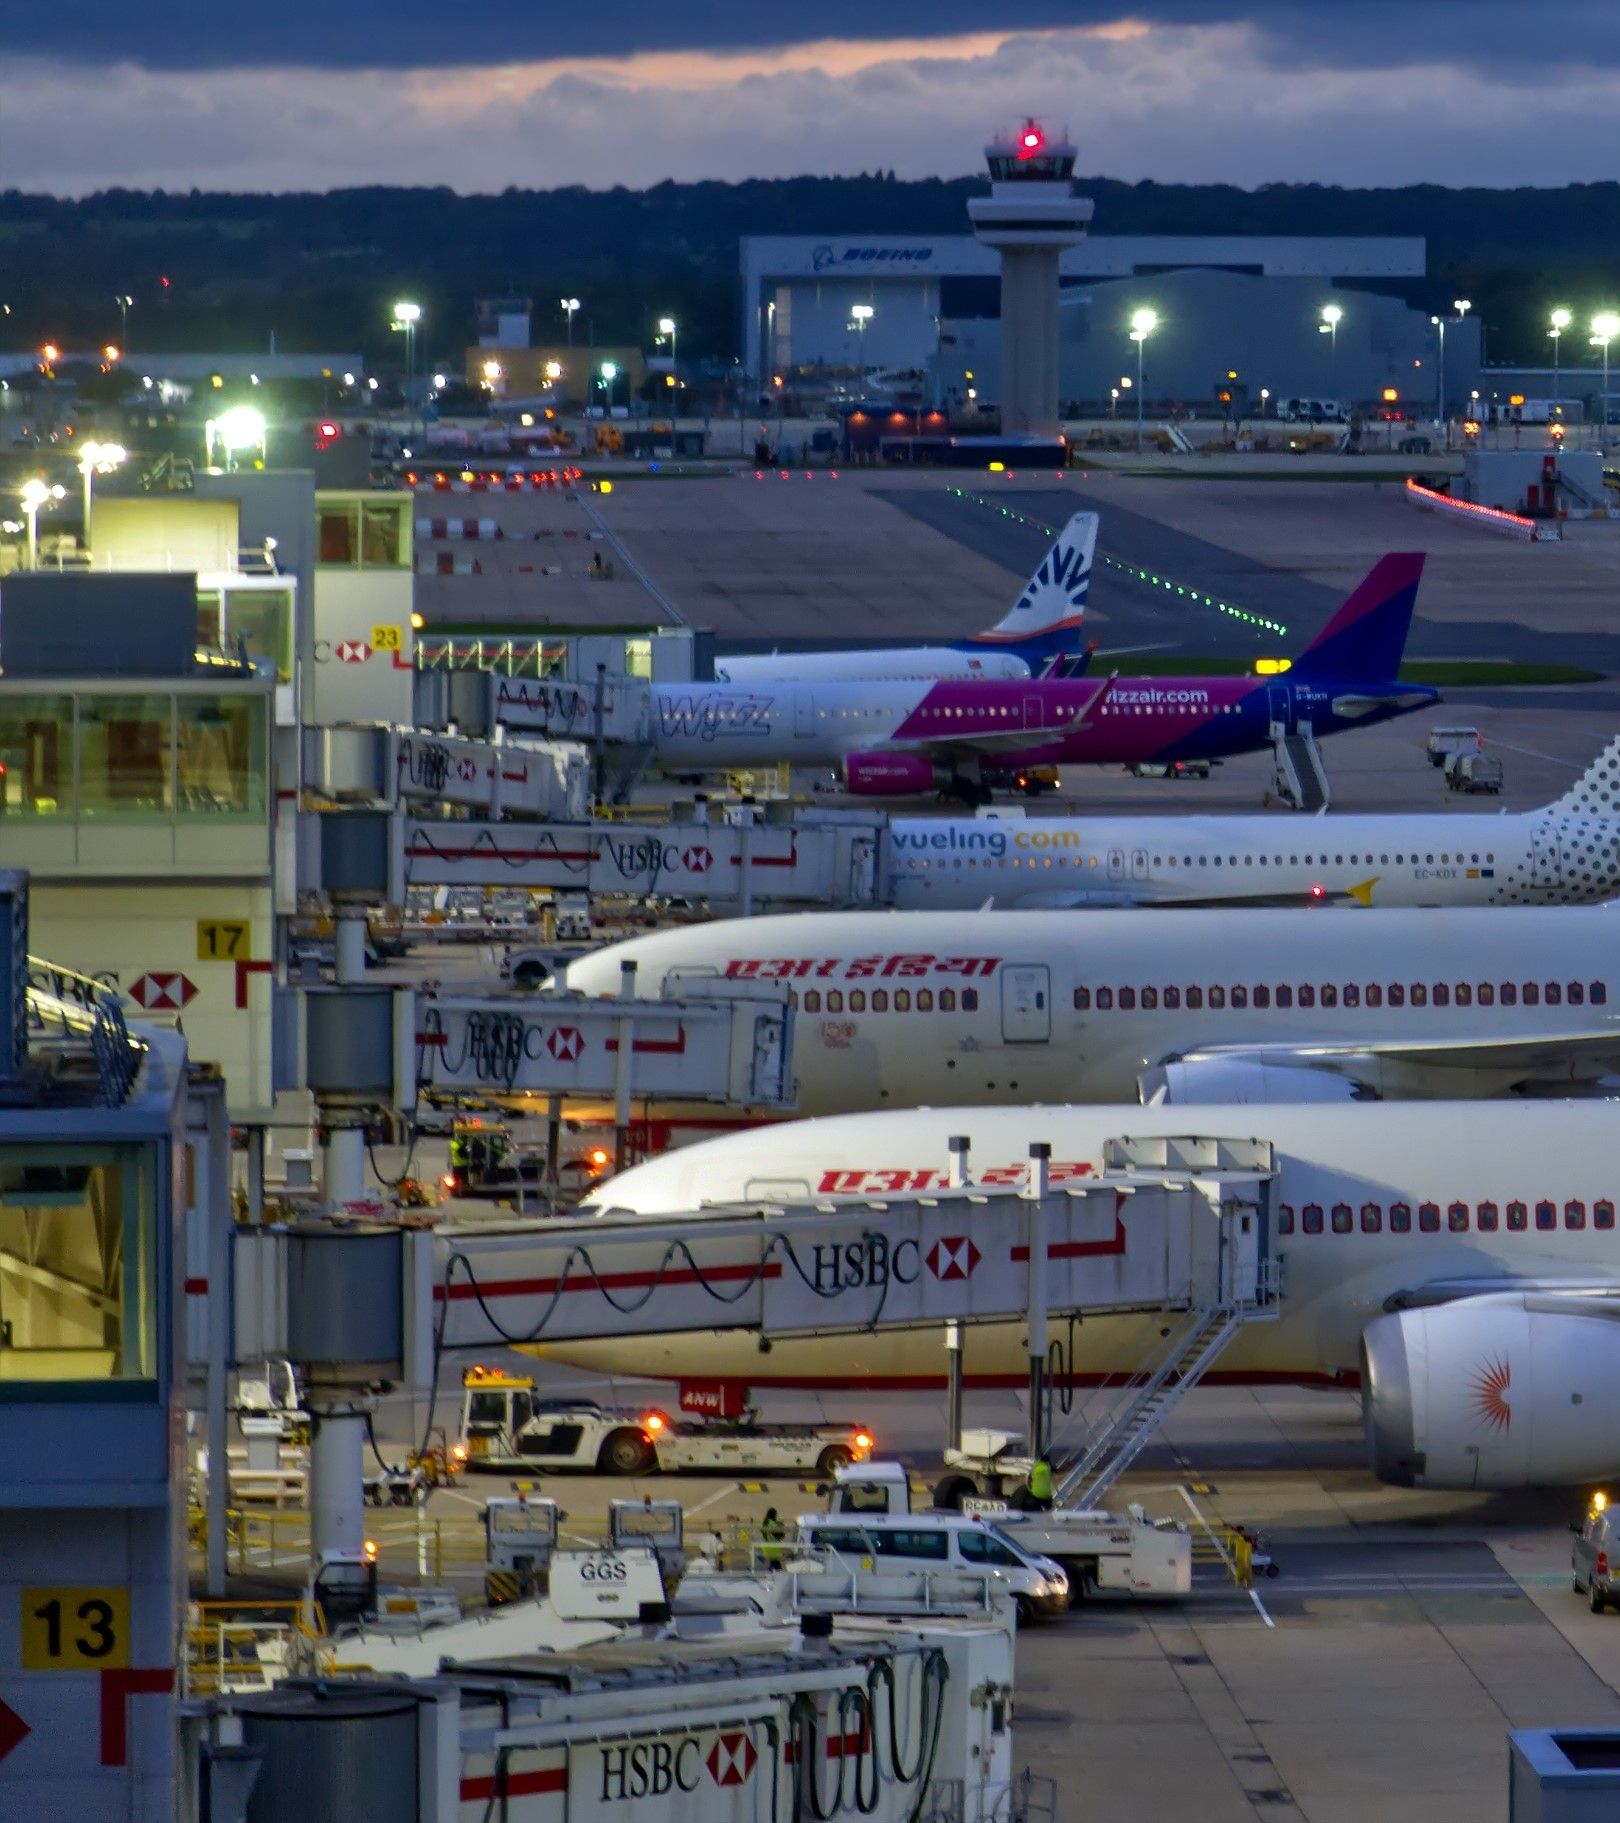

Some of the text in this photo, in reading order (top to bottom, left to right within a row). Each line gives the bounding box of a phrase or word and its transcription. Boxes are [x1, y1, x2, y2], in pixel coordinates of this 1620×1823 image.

[375, 629, 398, 647] 23
[618, 842, 680, 873] HSBC
[203, 925, 245, 956] 17
[812, 1239, 920, 1291] HSBC
[580, 1560, 628, 1581] GGS
[34, 1599, 117, 1658] 13
[599, 1737, 701, 1803] HSBC
